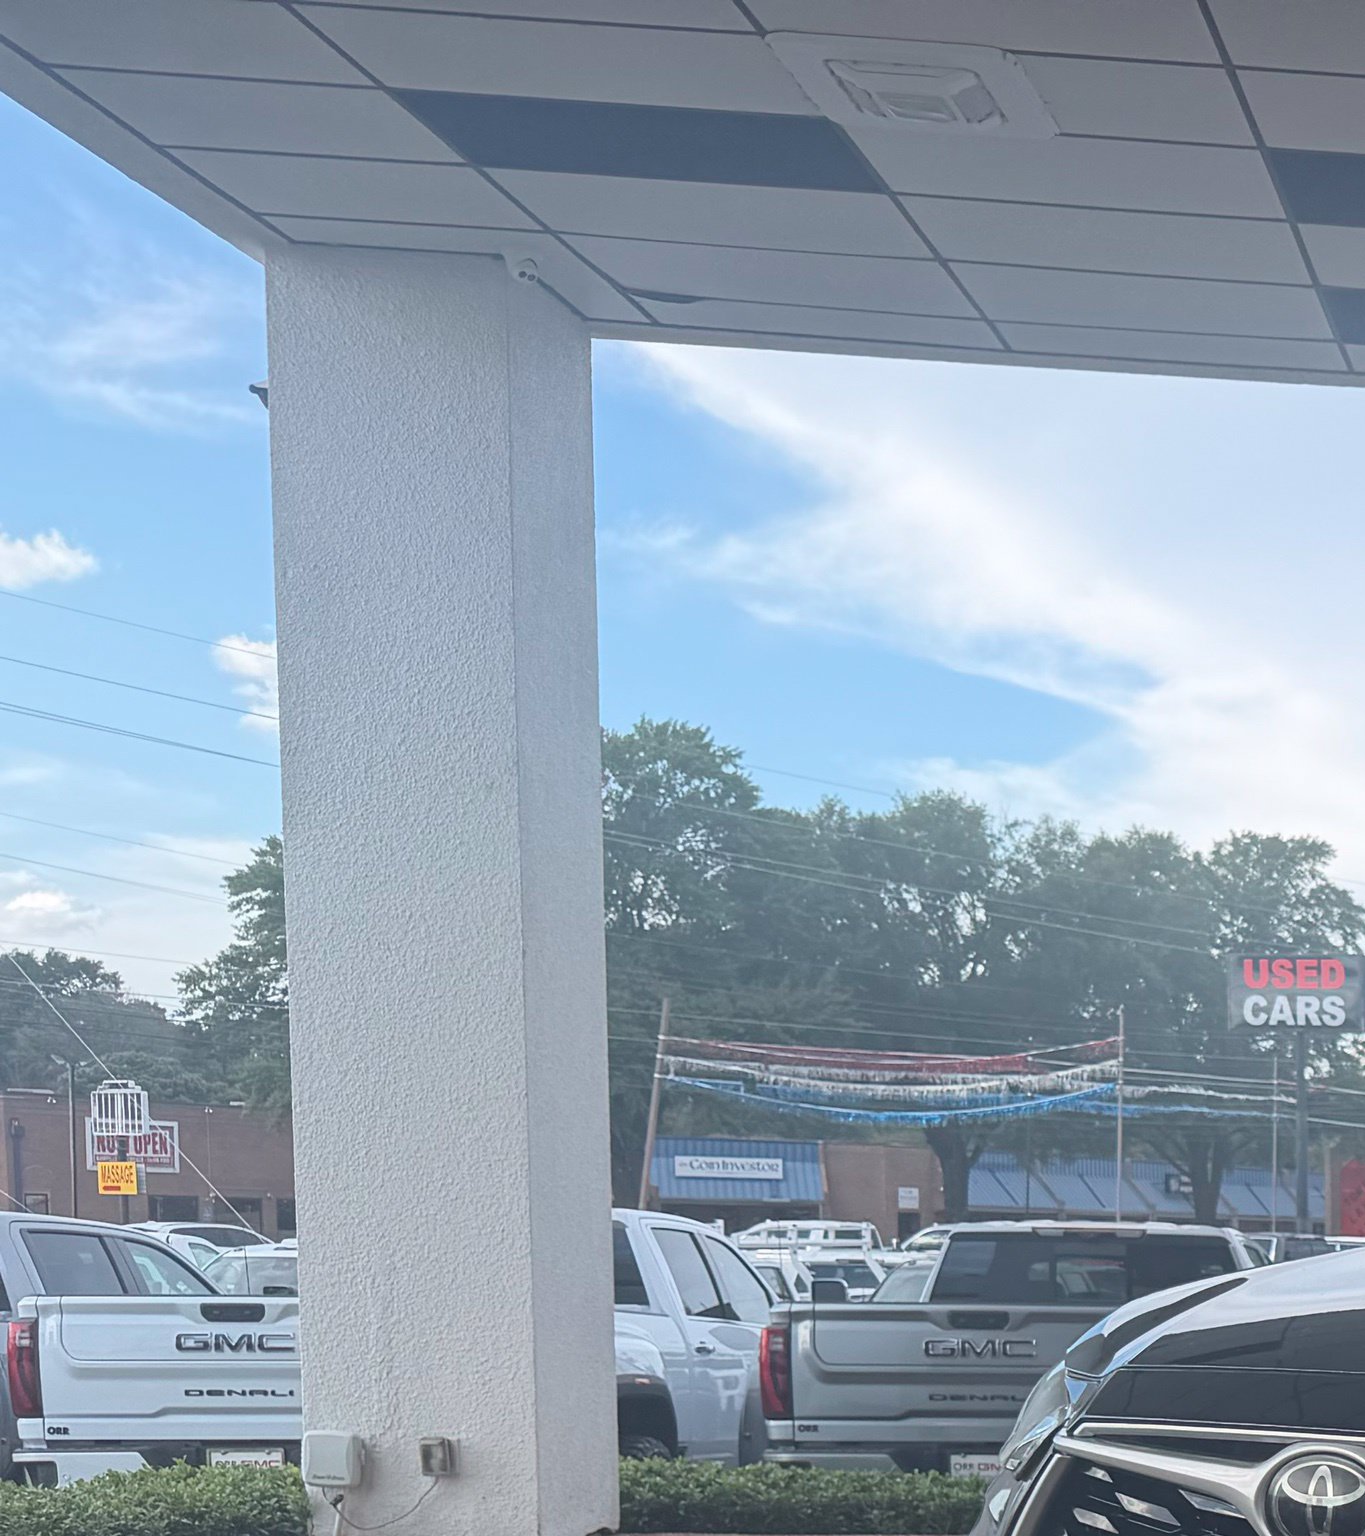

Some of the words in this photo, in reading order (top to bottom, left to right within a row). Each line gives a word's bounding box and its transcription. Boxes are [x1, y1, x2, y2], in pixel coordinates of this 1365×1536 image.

[1243, 958, 1346, 990] USED
[1243, 994, 1347, 1027] CARS
[133, 1131, 169, 1156] OPEN
[101, 1165, 134, 1184] MASSAGE
[175, 1332, 296, 1353] GMC
[923, 1338, 1037, 1358] GMC
[184, 1389, 295, 1397] DENALI
[928, 1393, 1027, 1402] DENAL
[47, 1426, 70, 1435] ORR
